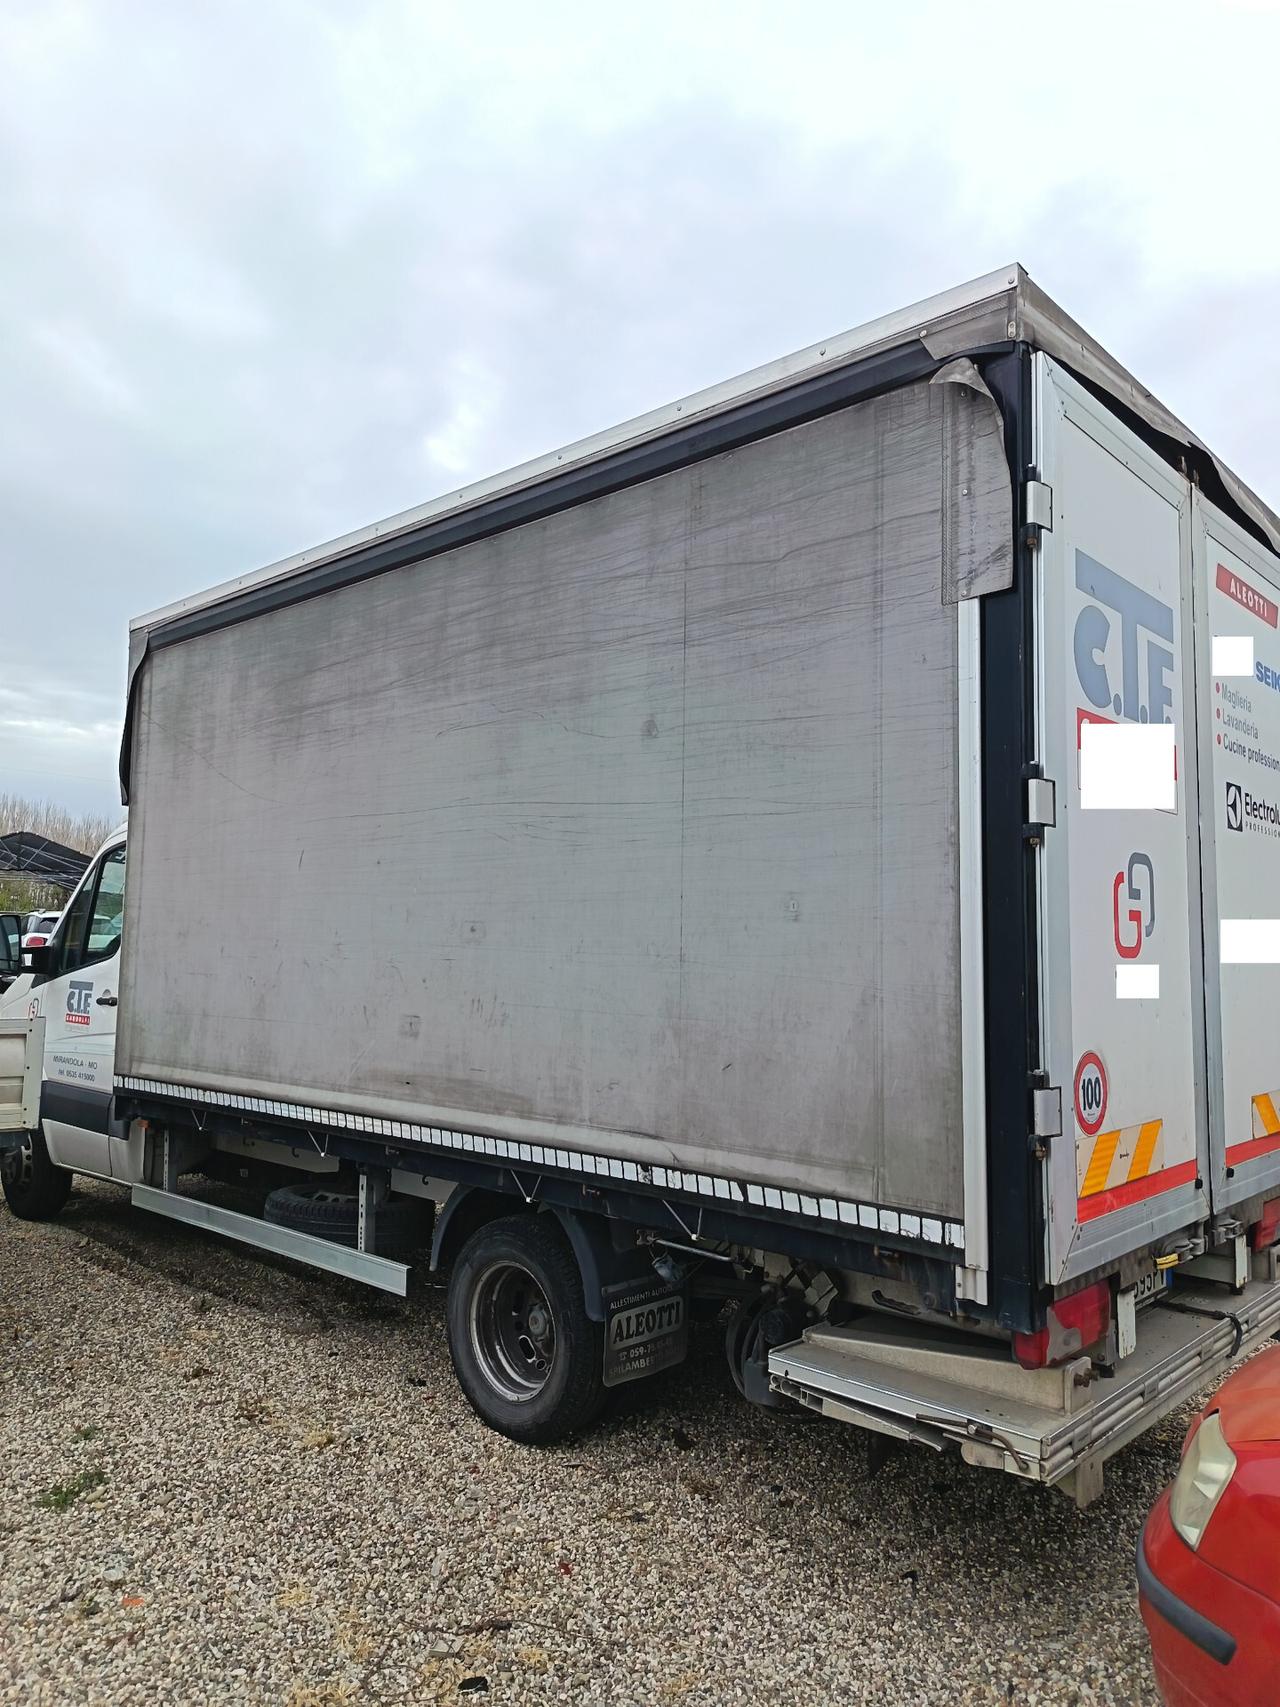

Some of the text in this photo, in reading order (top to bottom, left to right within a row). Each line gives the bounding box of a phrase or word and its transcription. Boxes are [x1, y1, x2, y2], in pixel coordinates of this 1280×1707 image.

[1230, 578, 1267, 617] ALEOTTI
[1221, 682, 1252, 713] Maglieria
[1222, 712, 1259, 739] Lavanderia
[1223, 733, 1246, 757] Cucine
[53, 1055, 83, 1067] MIRANDOLA
[87, 1061, 98, 1070] MO
[1081, 1076, 1101, 1111] 100
[613, 1301, 681, 1344] ALEOTTI
